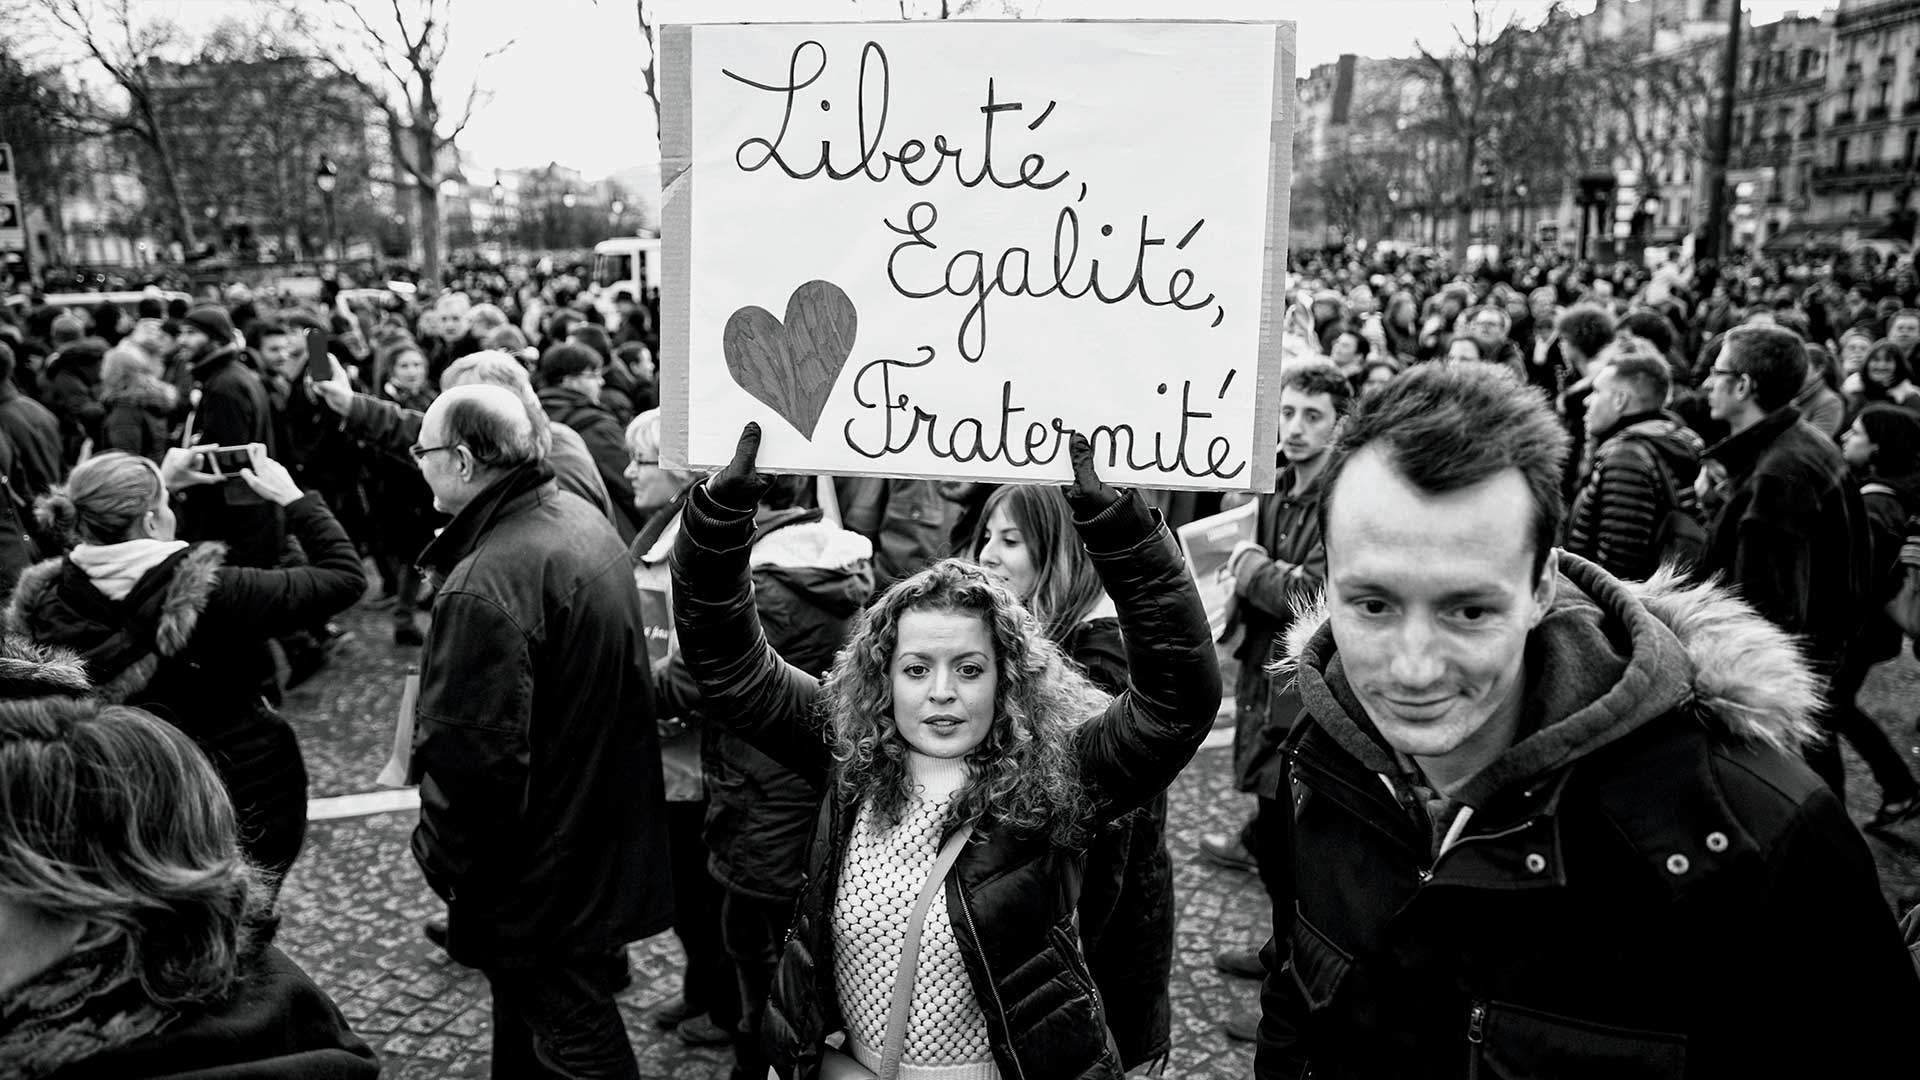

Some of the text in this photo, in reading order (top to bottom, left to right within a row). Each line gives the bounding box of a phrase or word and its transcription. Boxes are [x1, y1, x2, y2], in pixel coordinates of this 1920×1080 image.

[722, 40, 1087, 203] Liberté,
[884, 202, 1225, 363] Egalité,
[844, 346, 1246, 480] Fraternité
